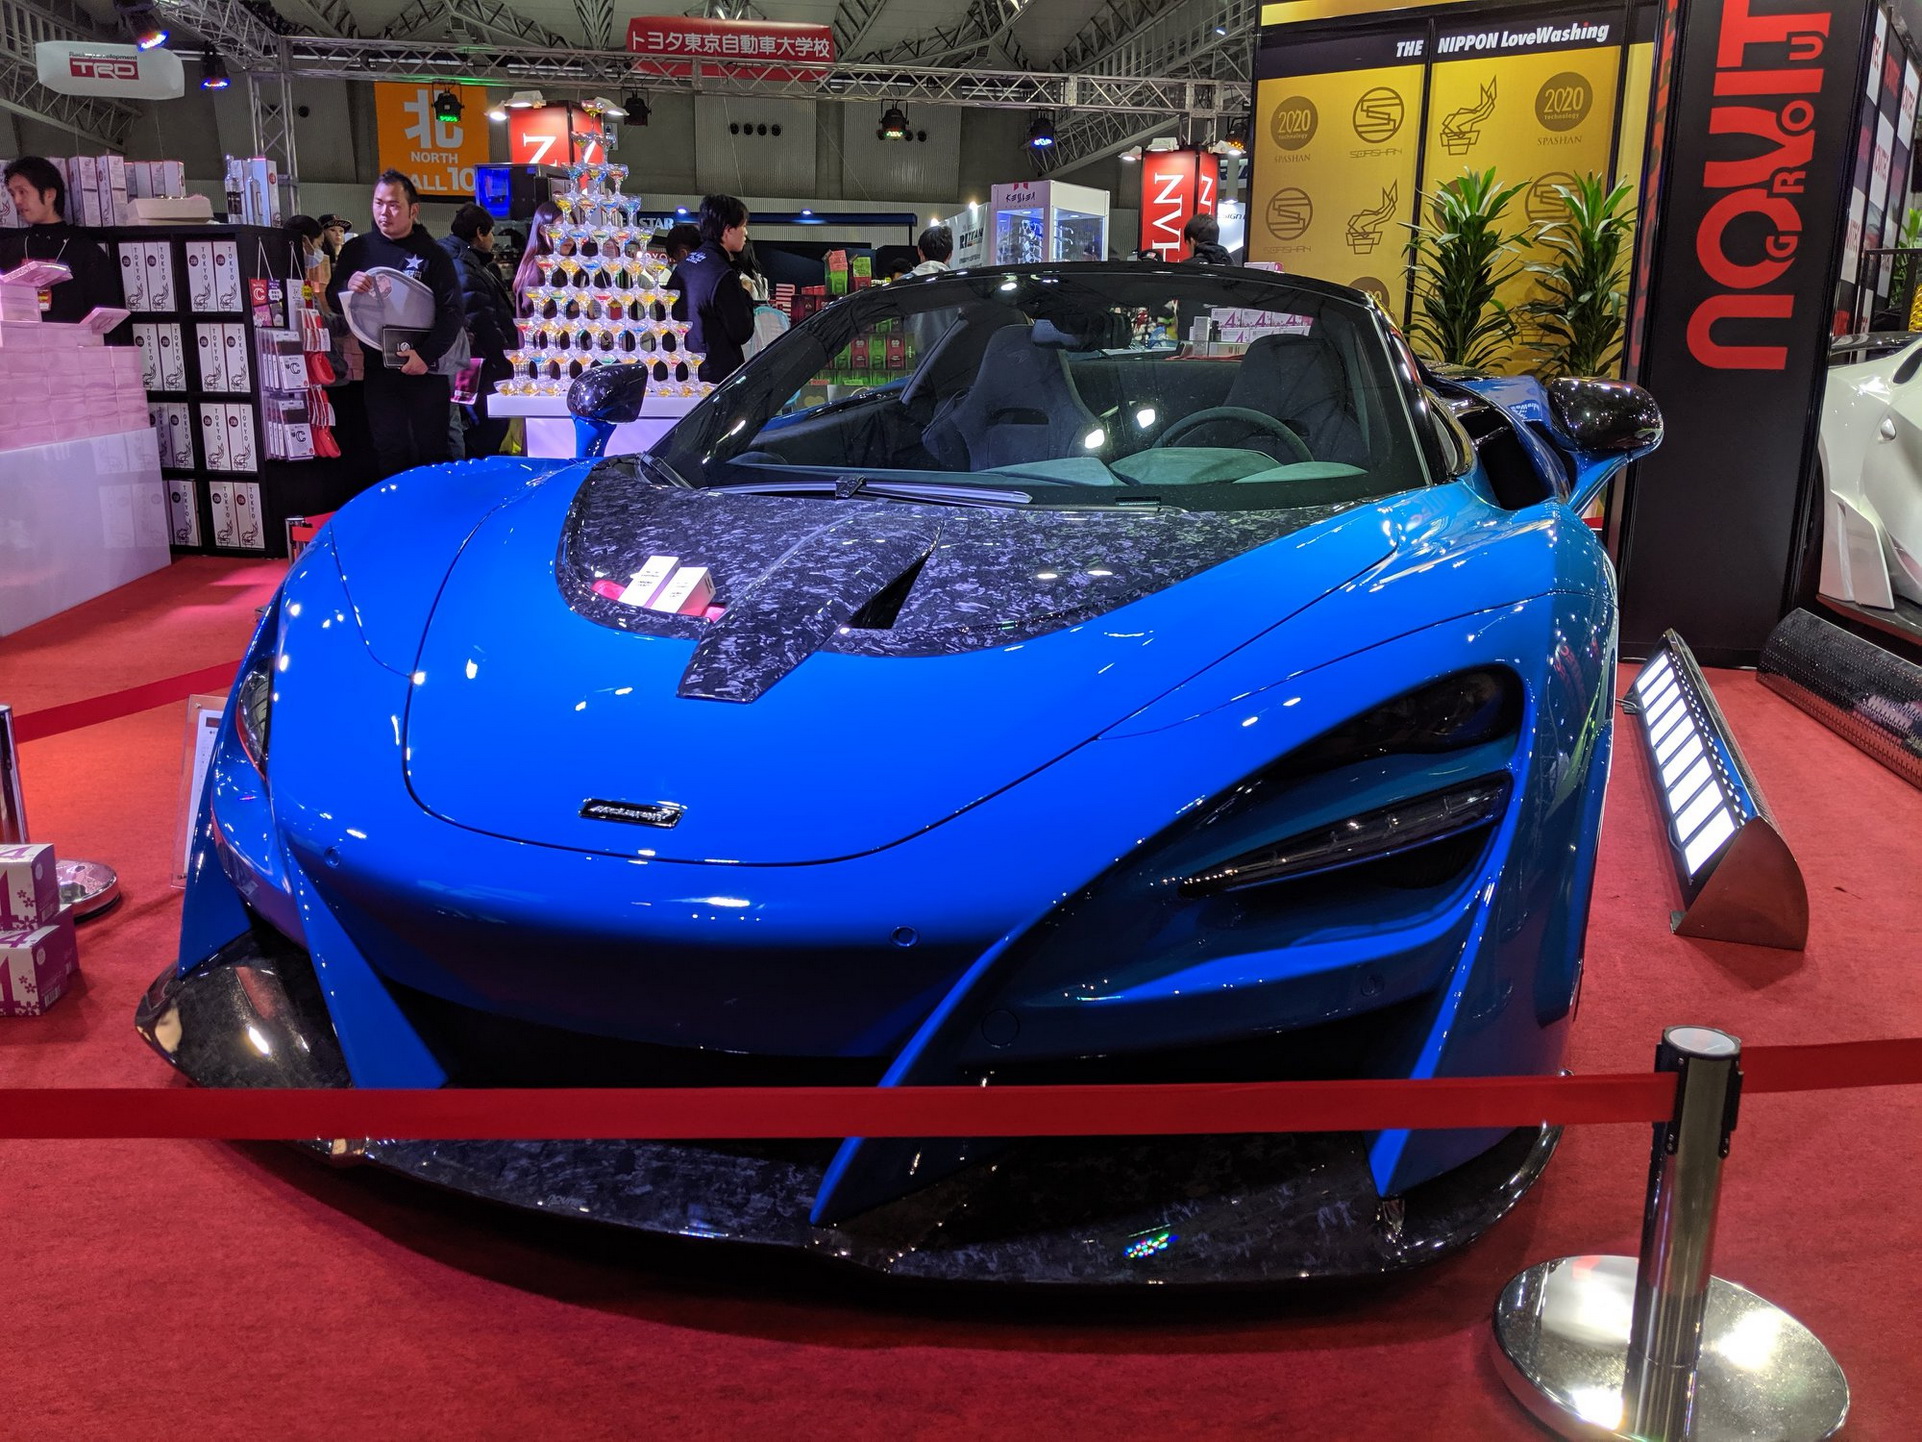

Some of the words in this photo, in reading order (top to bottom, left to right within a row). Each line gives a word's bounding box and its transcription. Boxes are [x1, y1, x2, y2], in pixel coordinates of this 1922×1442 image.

[632, 31, 830, 58] トヨタ東京自動車大学校
[1396, 39, 1424, 58] THE
[1437, 31, 1499, 54] NIPPON
[1500, 21, 1609, 48] LoveWashing
[72, 61, 135, 79] TRD
[1543, 86, 1584, 113] 2020
[403, 88, 464, 149] 北
[1278, 108, 1311, 133] 2020
[410, 151, 458, 164] NORTH
[1274, 153, 1311, 164] SPASHAN
[411, 174, 447, 191] ALL
[446, 166, 476, 191] 10
[133, 247, 141, 281] TOKYO
[159, 246, 167, 281] TOKYO
[227, 246, 235, 281] TOKYO
[173, 328, 181, 361] TOKYO
